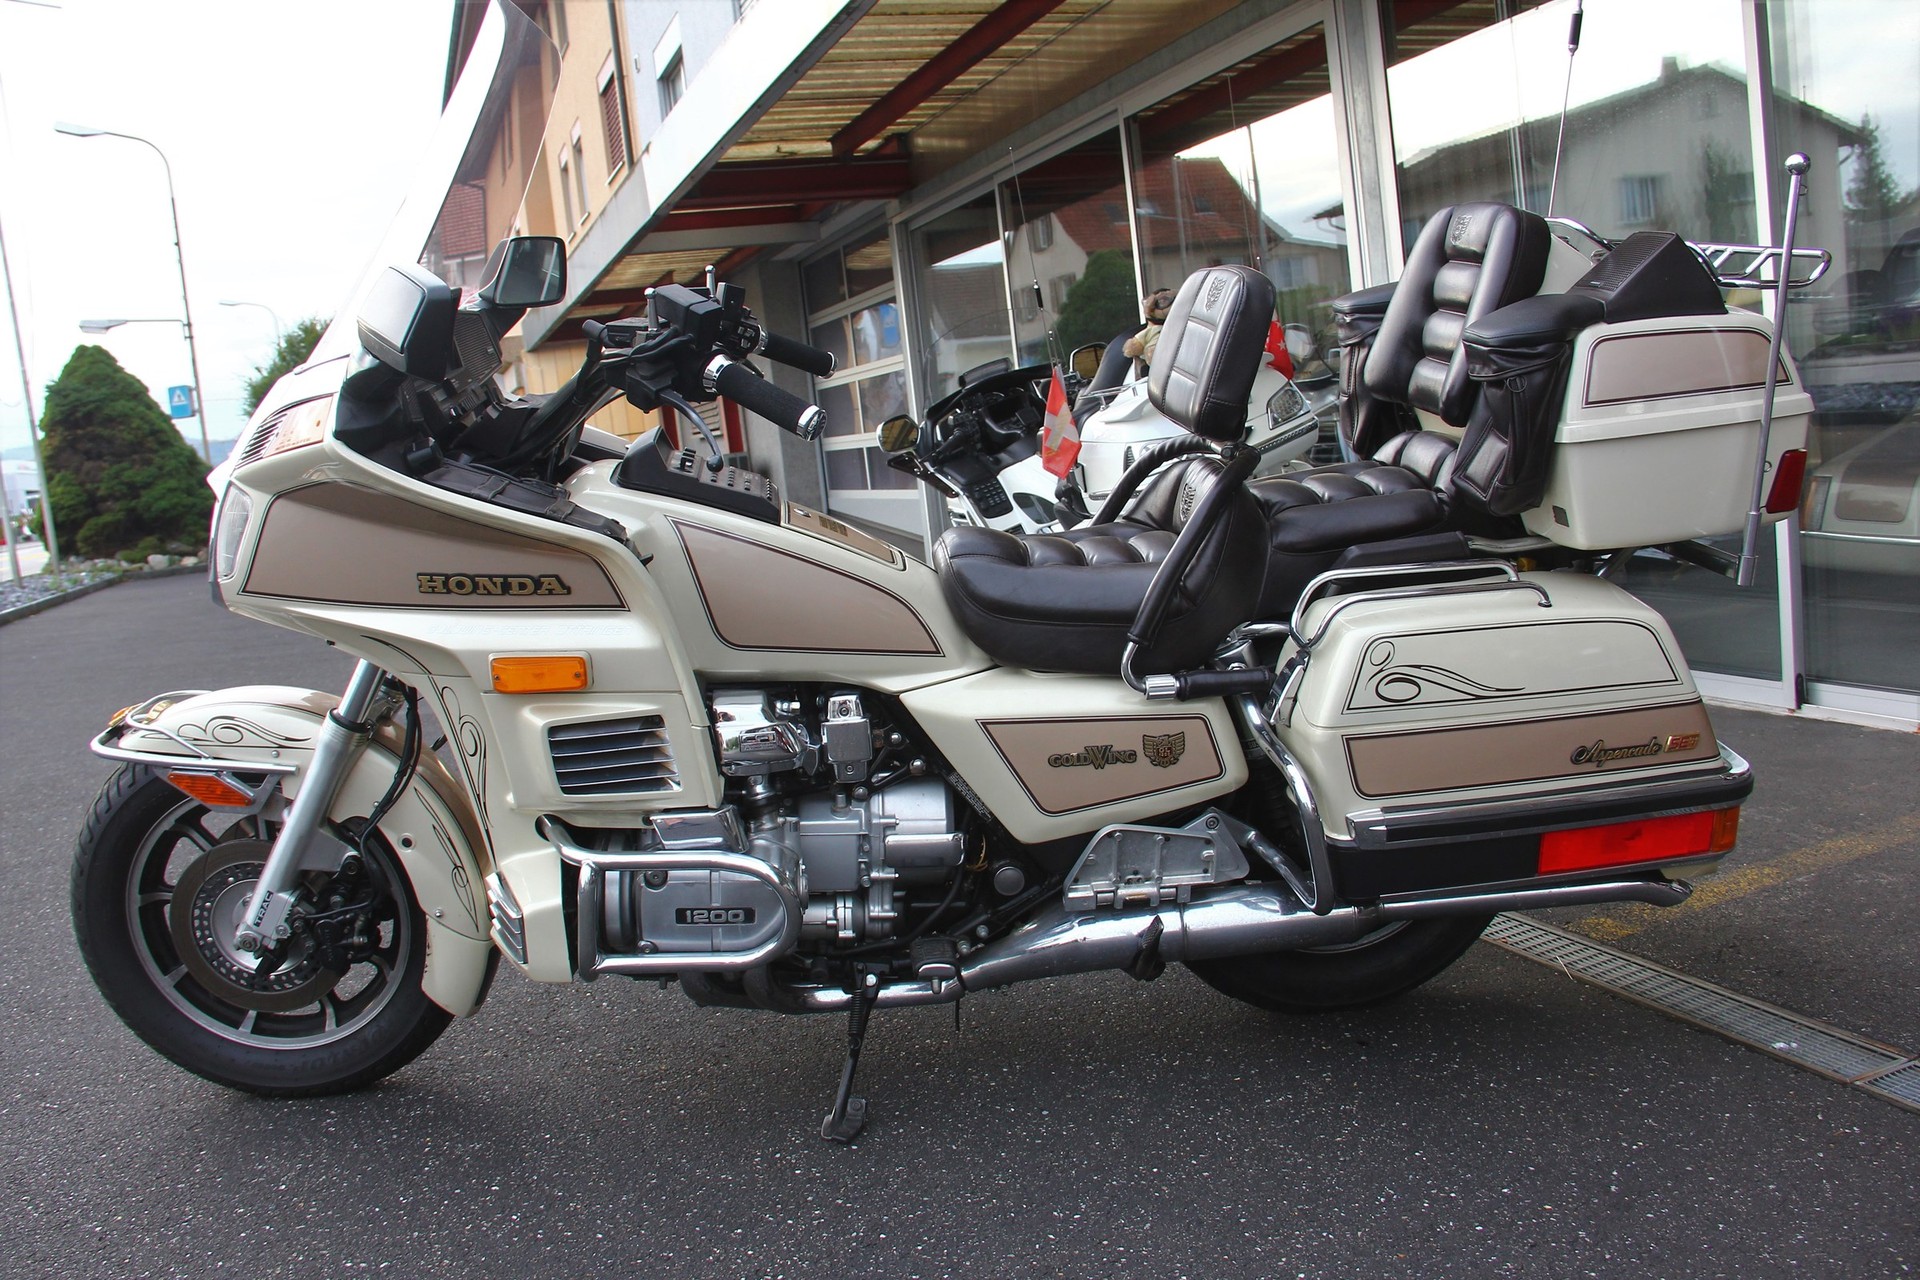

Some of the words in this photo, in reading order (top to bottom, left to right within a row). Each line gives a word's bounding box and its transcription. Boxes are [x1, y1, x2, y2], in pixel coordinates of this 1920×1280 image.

[417, 573, 571, 596] HONDA
[1048, 745, 1137, 769] GOLDWING
[1570, 737, 1662, 767] Aspencade
[254, 891, 274, 927] TRAC
[685, 909, 745, 923] 1200
